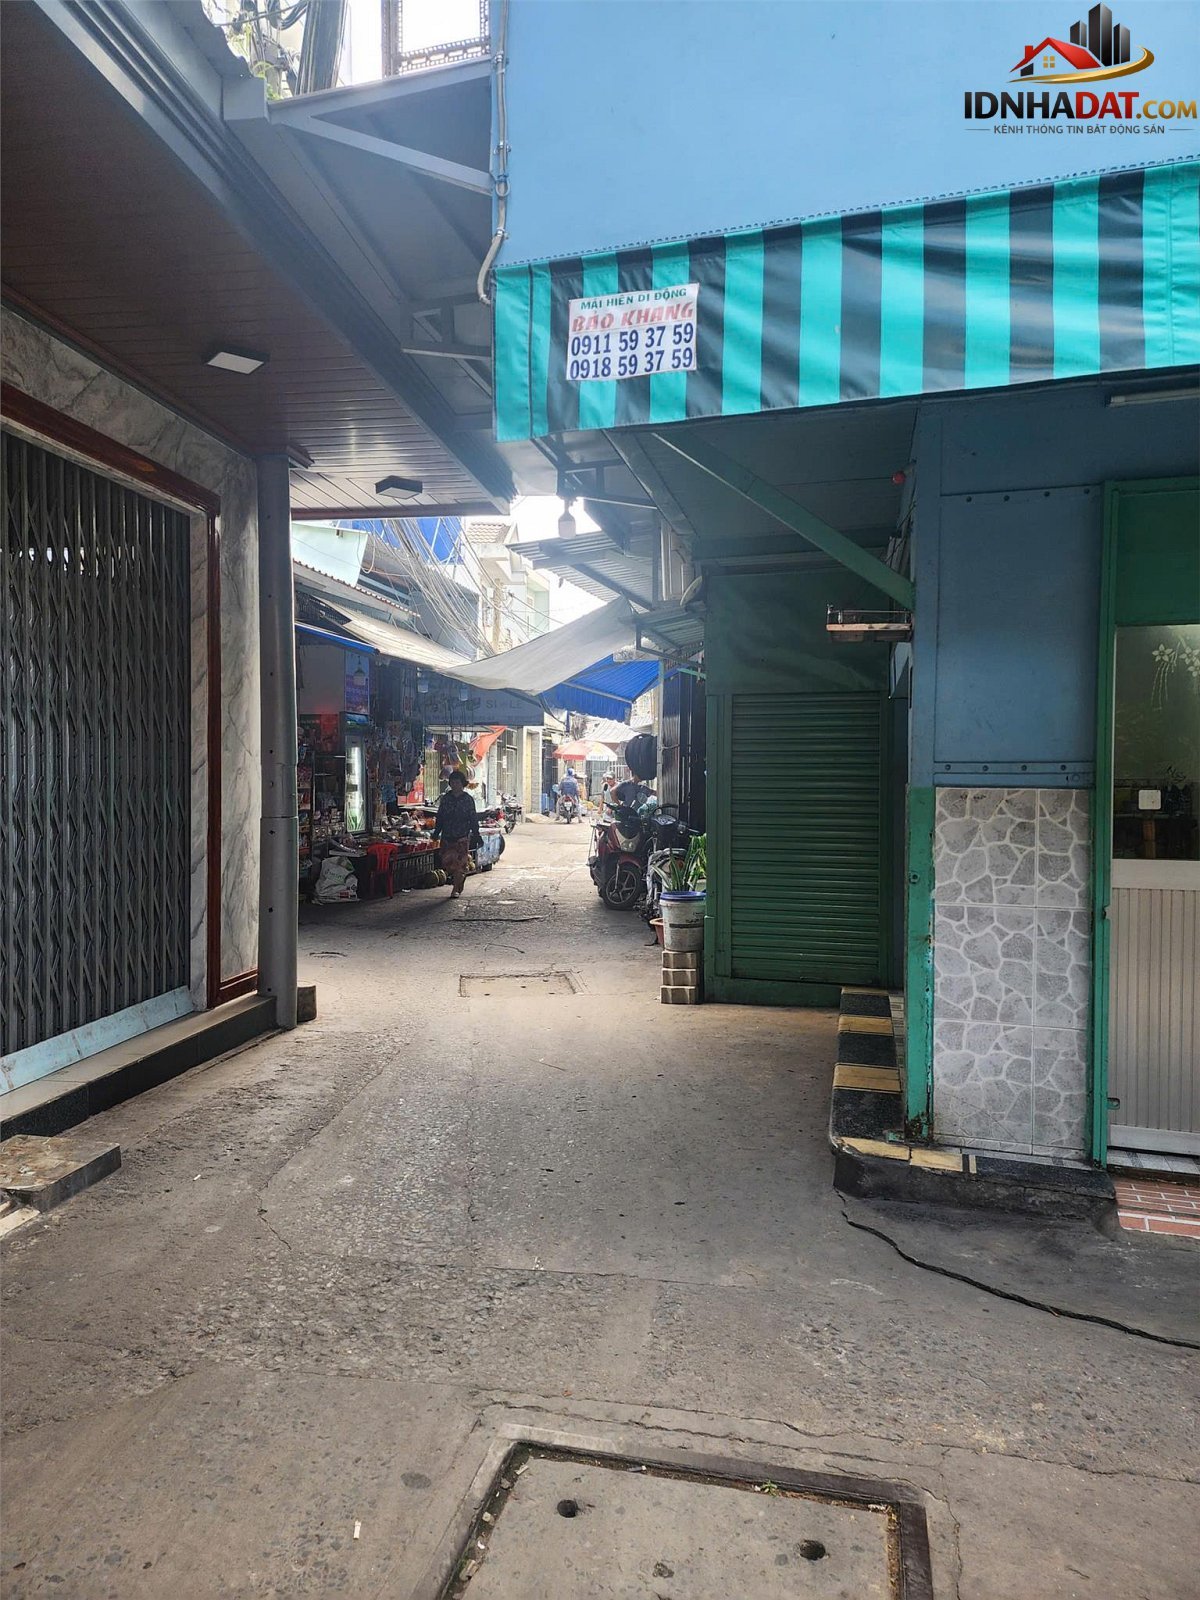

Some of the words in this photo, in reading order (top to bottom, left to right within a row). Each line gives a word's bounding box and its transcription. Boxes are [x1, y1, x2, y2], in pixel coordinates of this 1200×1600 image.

[581, 298, 602, 310] MÁI
[606, 294, 634, 307] HIÊN
[638, 293, 650, 302] DI
[654, 287, 687, 300] ĐỘNG
[620, 302, 694, 326] KHANG
[571, 333, 611, 356] 0911
[619, 329, 639, 352] 59
[645, 325, 666, 348] 37
[672, 322, 693, 345] 59
[570, 356, 611, 379] 0918
[618, 354, 638, 376] 59
[644, 350, 665, 373] 37
[671, 347, 692, 369] 59
